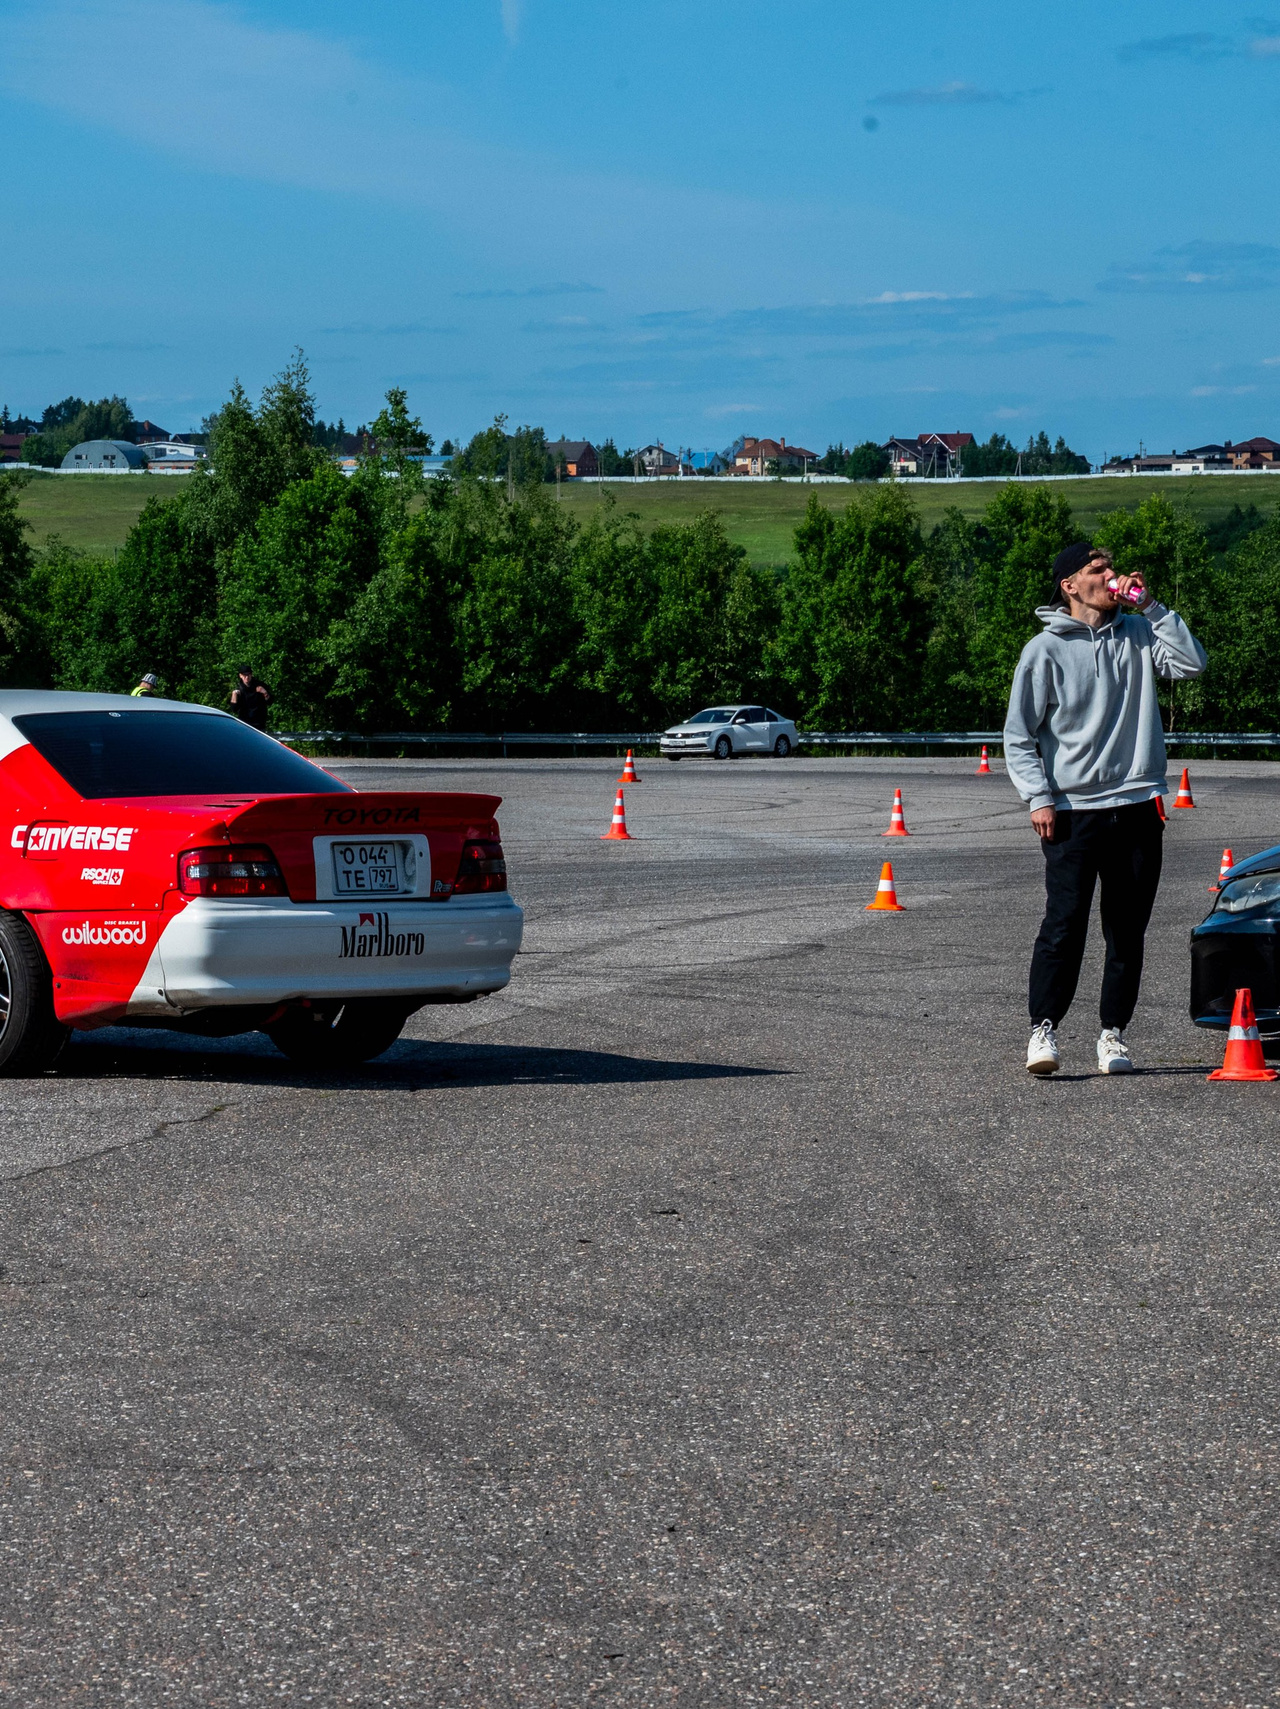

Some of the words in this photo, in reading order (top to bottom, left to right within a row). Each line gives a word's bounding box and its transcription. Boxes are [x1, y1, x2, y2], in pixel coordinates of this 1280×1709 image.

[324, 807, 420, 825] TOYOTA
[11, 825, 134, 851] CONVERSE
[359, 846, 387, 865] 044
[372, 869, 393, 883] 797
[62, 920, 147, 945] wilwood
[338, 912, 425, 958] Marlboro
